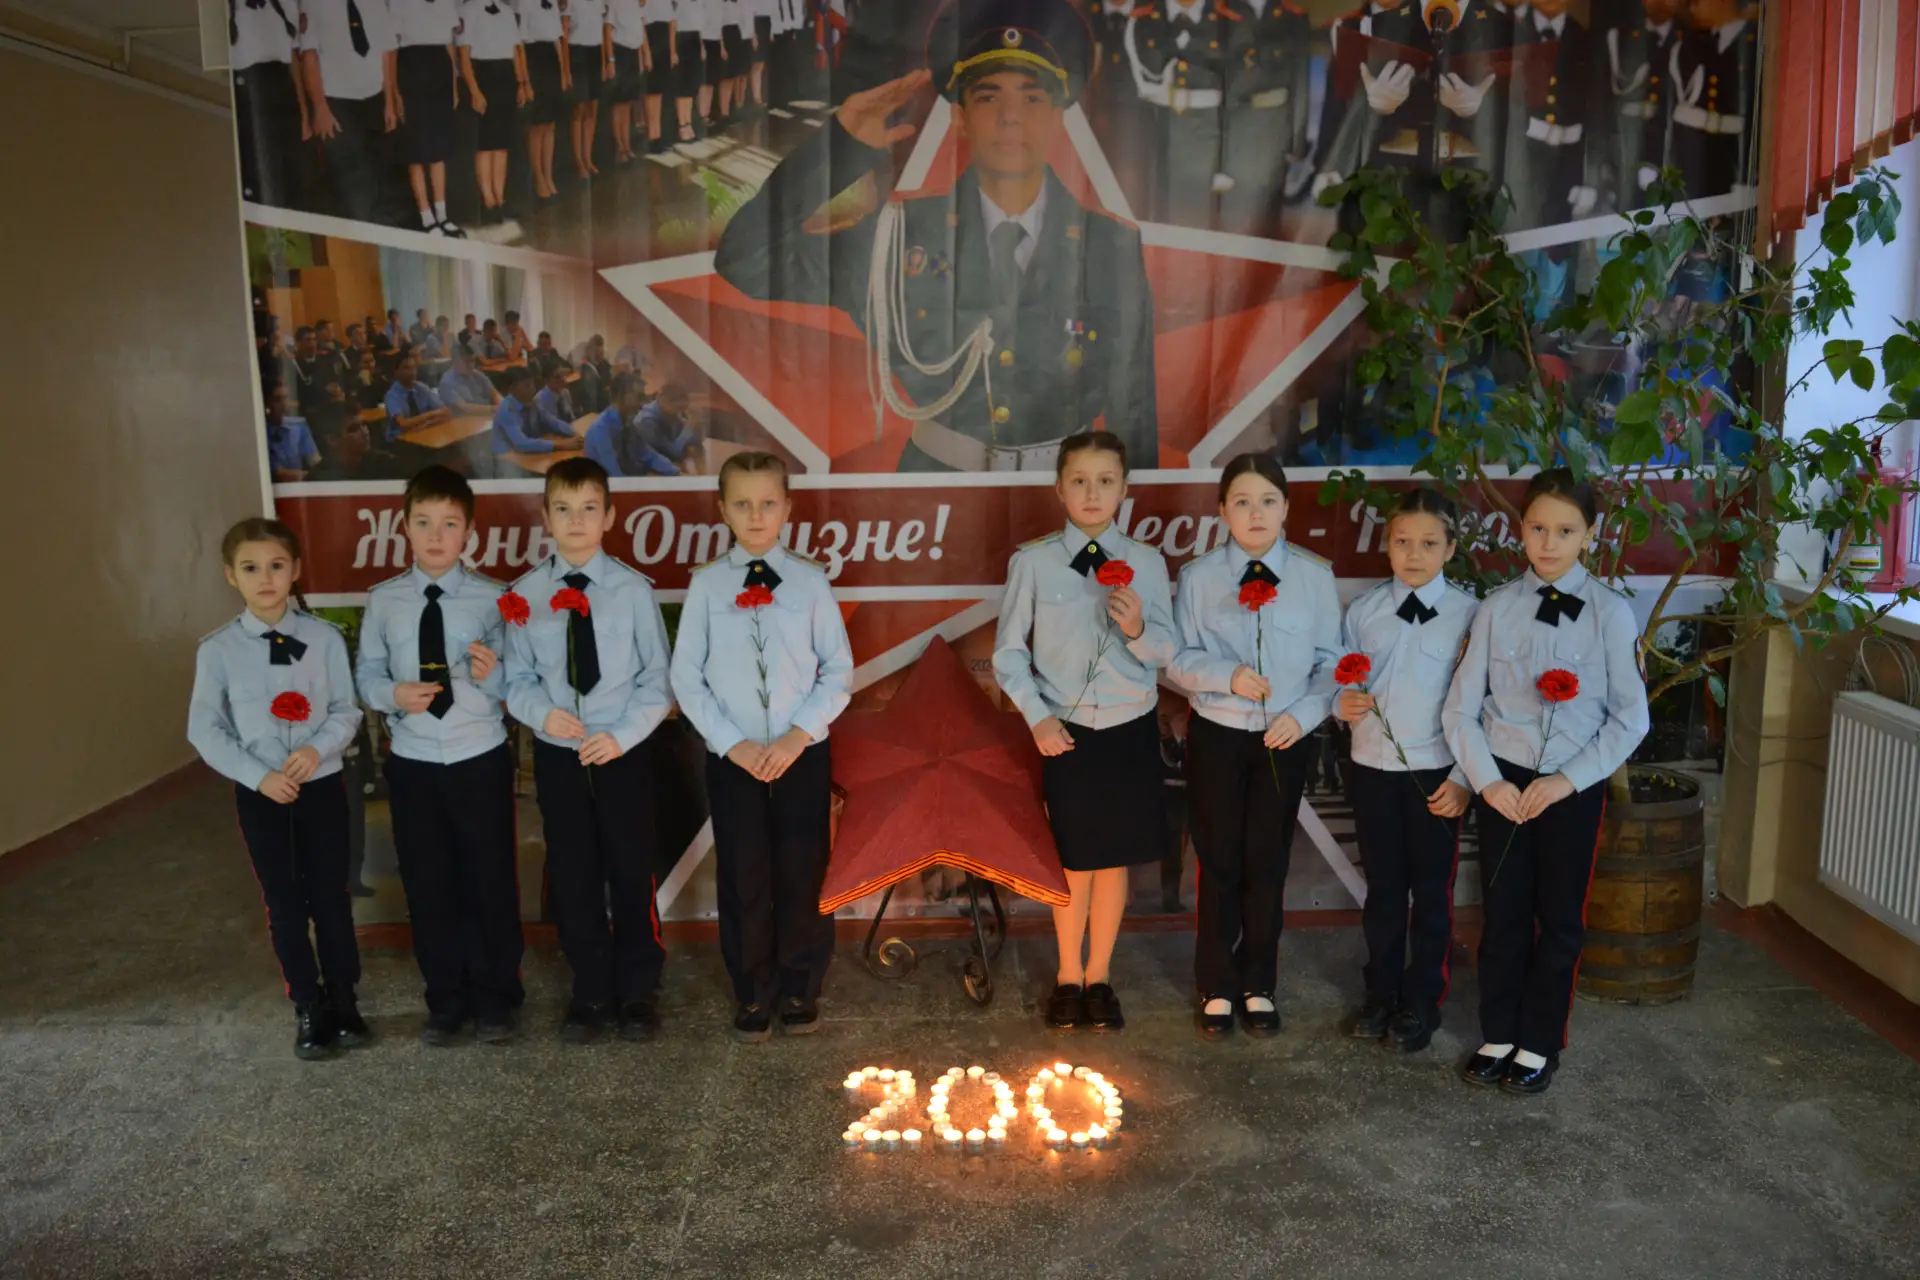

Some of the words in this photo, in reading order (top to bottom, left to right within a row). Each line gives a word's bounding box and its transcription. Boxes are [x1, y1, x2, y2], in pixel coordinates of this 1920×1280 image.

[352, 508, 558, 569] Жнь
[624, 504, 951, 581] Отизне!
[1117, 498, 1286, 557] ест
[843, 1065, 1123, 1149] 200
